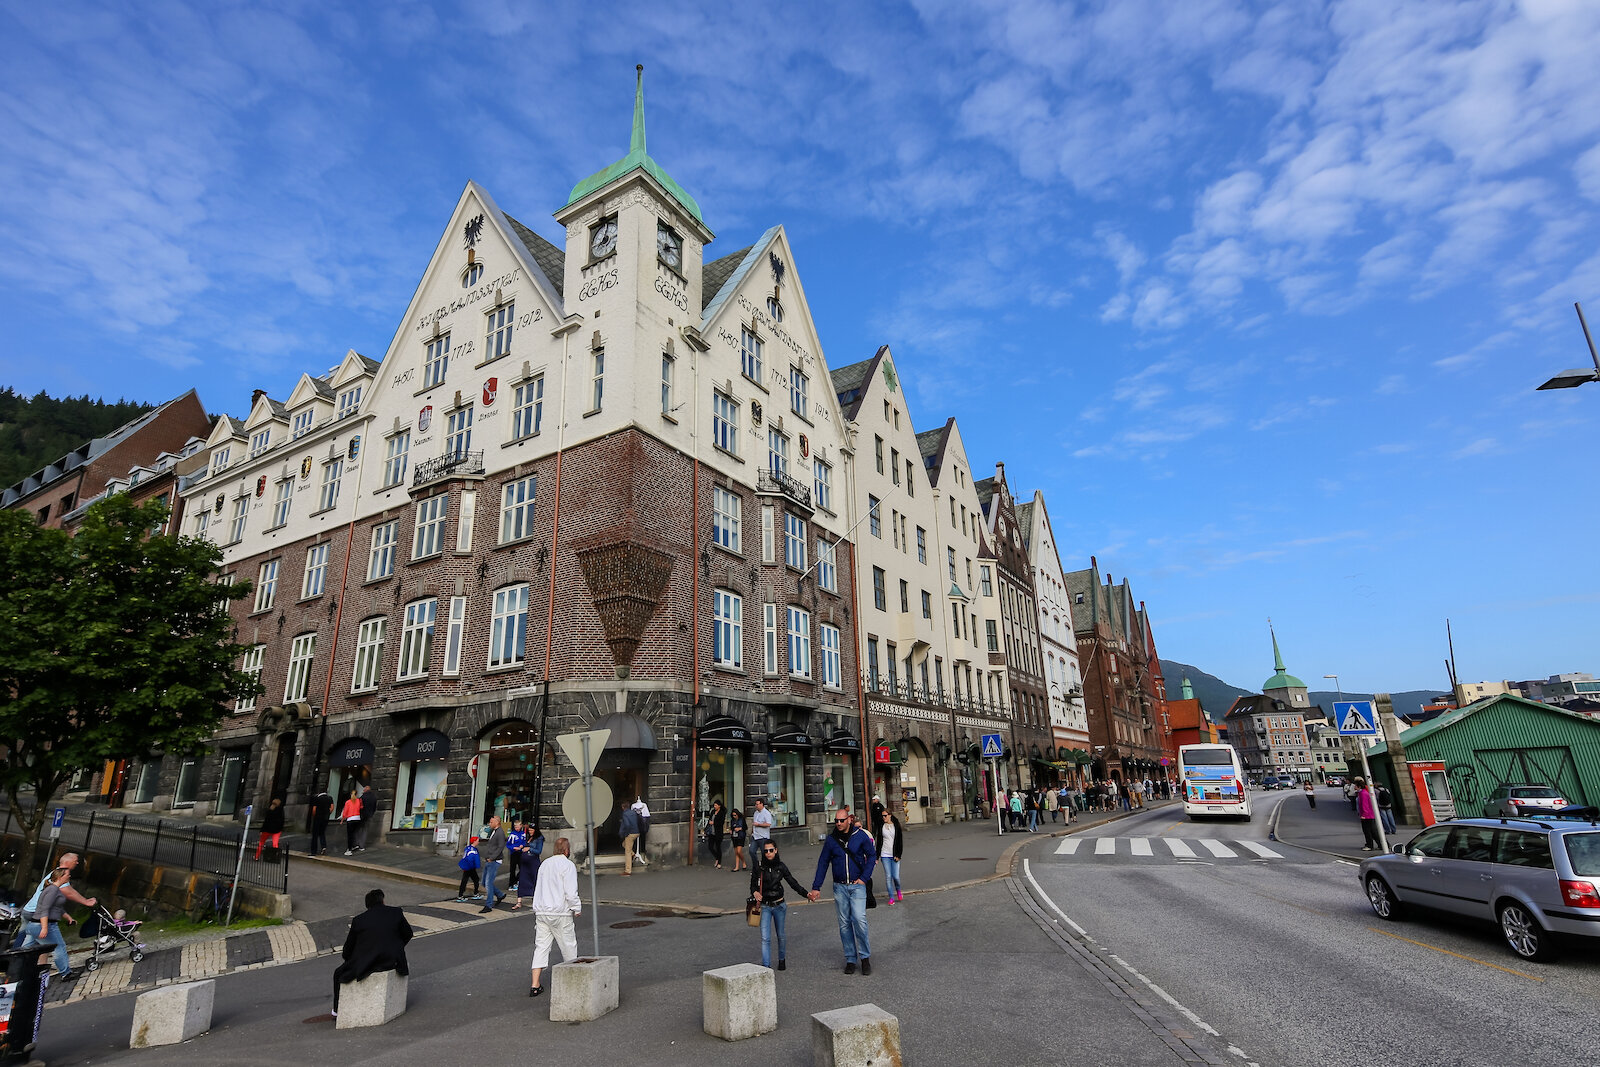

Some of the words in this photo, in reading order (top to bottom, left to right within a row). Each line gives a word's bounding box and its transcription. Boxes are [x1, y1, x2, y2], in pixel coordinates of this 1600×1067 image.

[417, 741, 436, 752] ROST
[346, 749, 363, 759] ROST
[54, 810, 62, 825] P
